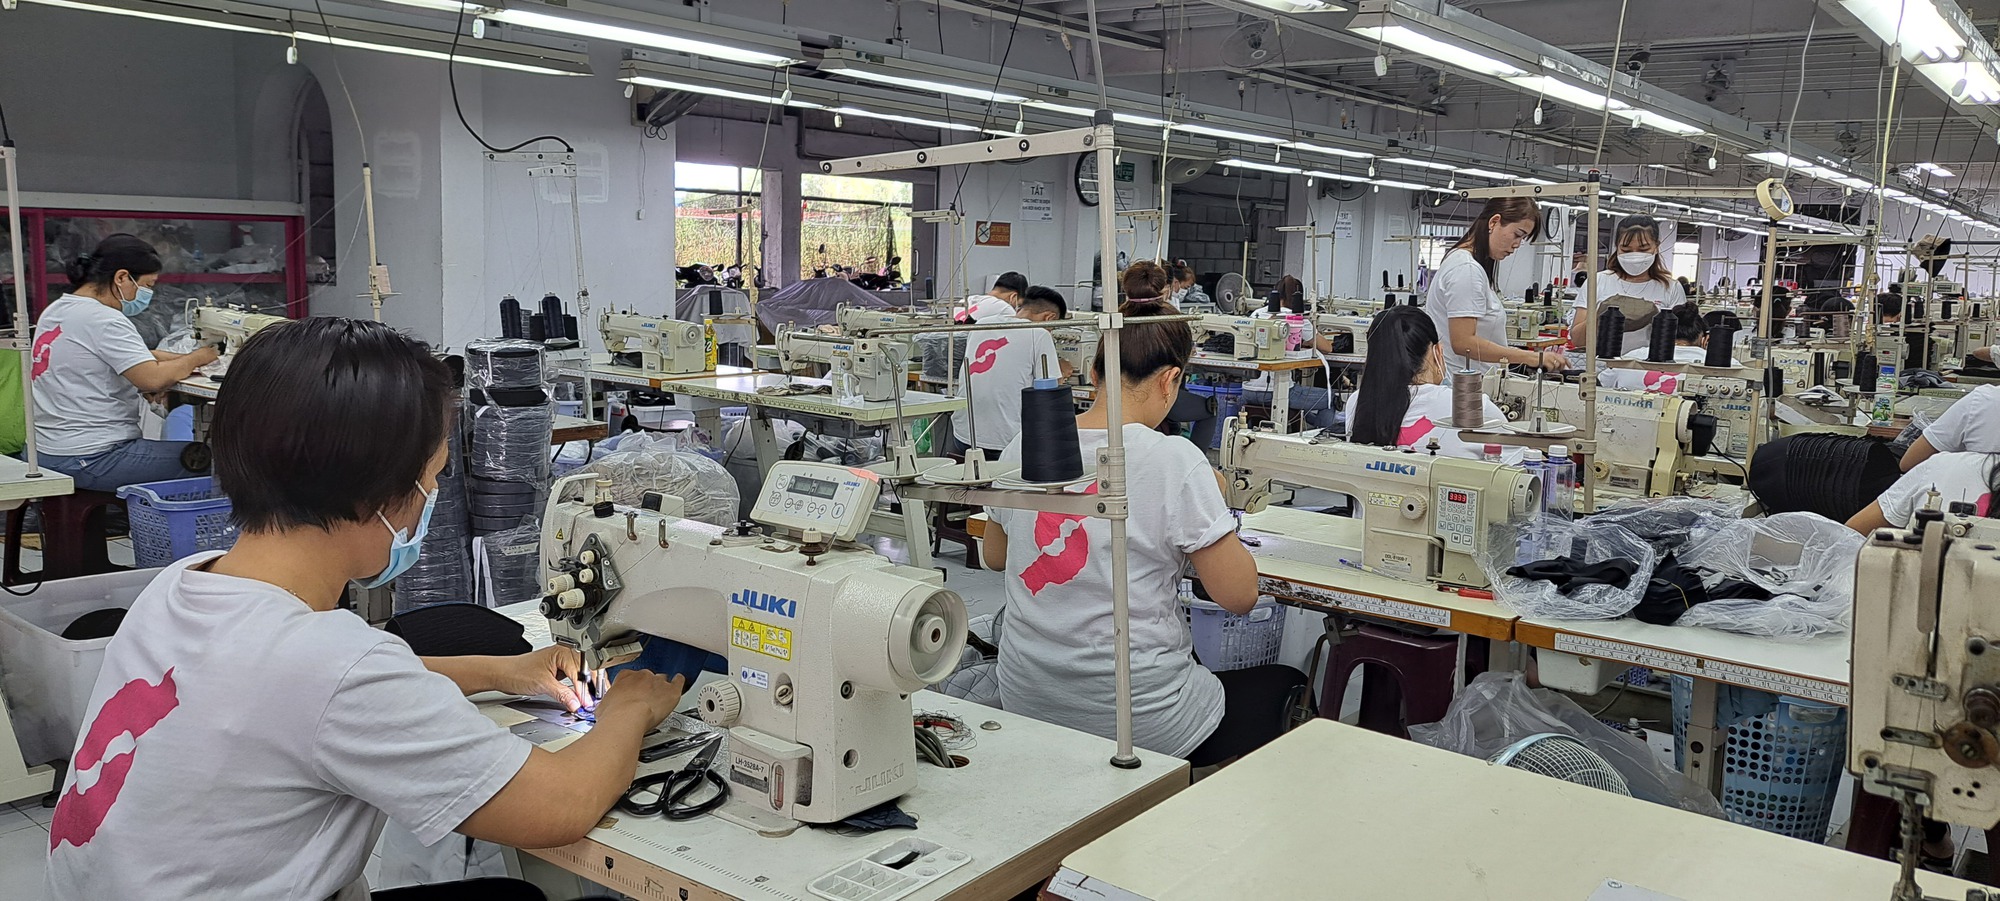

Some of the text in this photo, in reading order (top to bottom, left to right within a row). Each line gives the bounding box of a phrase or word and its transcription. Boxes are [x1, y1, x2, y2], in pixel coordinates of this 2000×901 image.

[1721, 403, 1751, 411] JUKI
[1366, 460, 1416, 476] JUKI
[732, 588, 797, 618] JUKI
[735, 756, 765, 773] LH-3528A-7
[855, 763, 904, 796] JUKI
